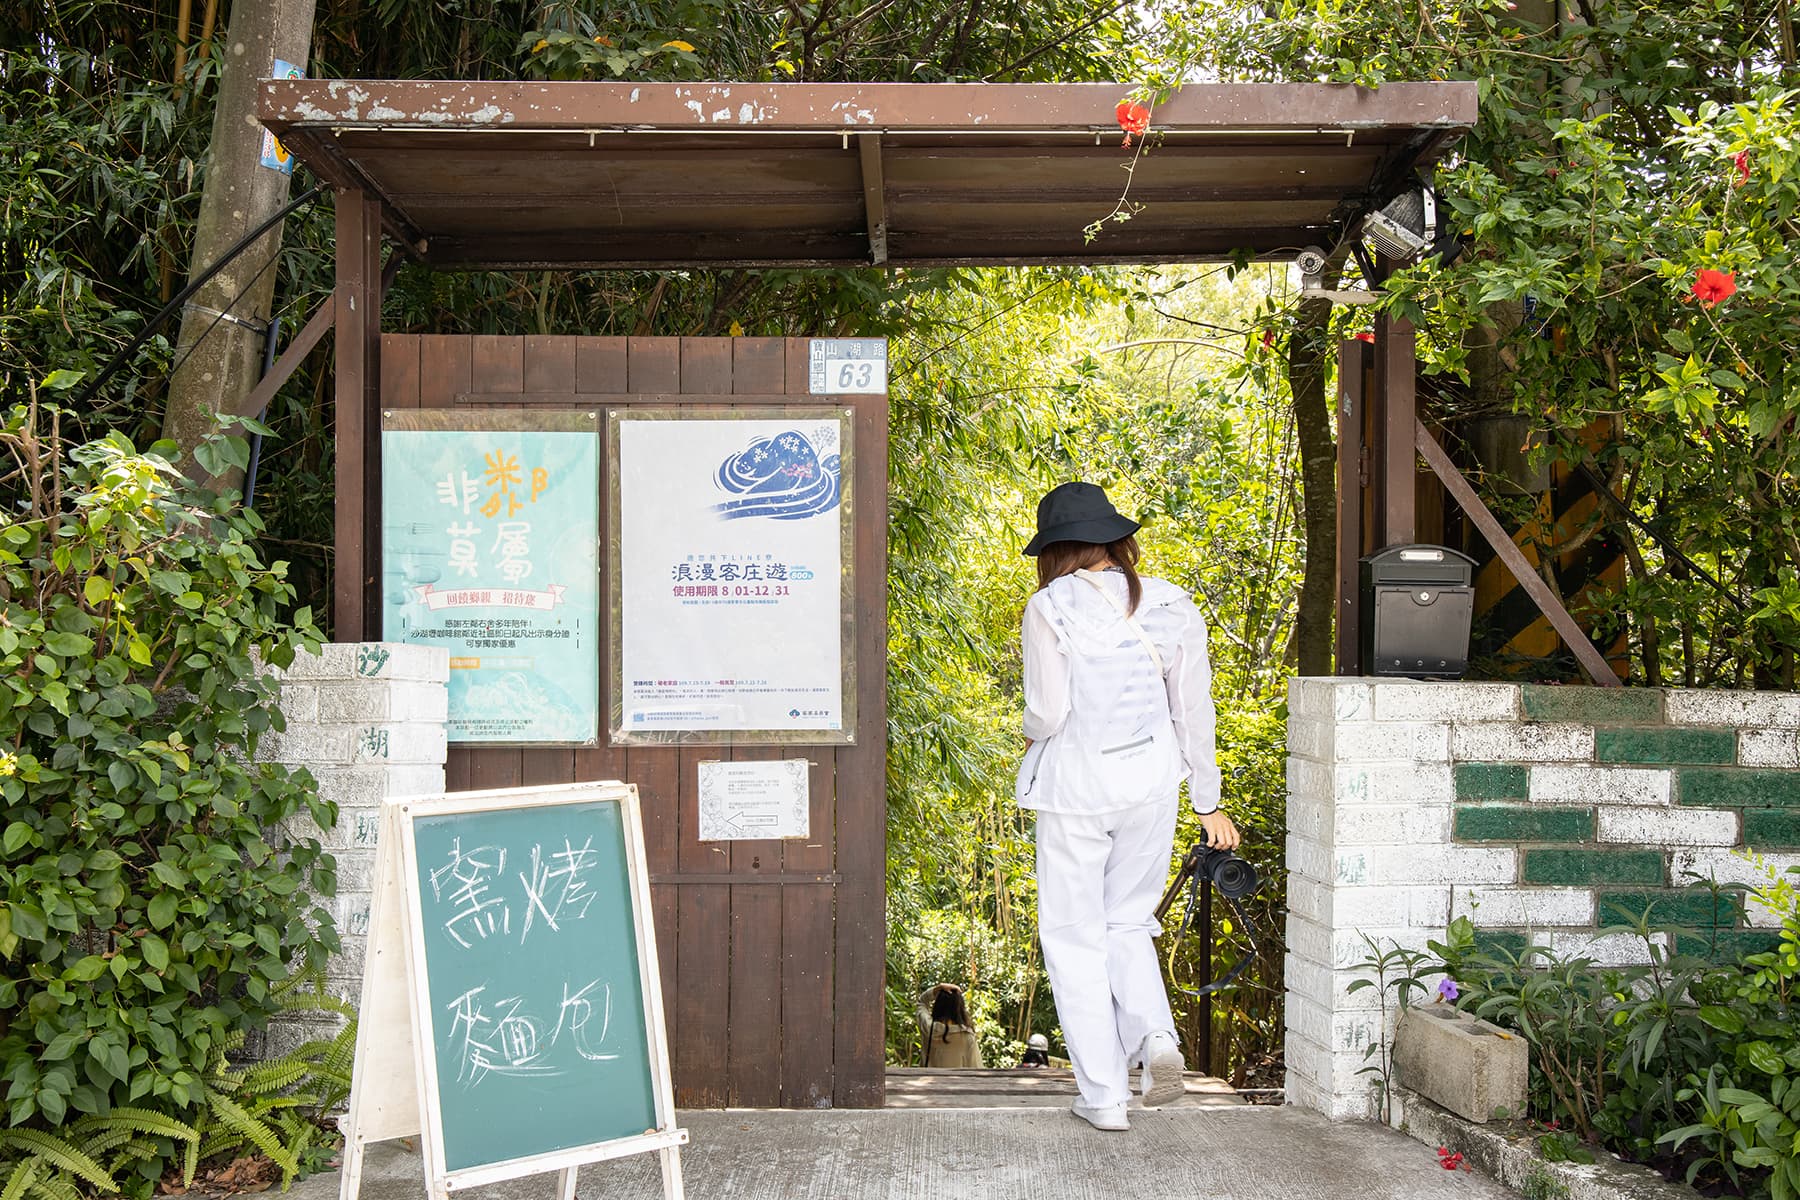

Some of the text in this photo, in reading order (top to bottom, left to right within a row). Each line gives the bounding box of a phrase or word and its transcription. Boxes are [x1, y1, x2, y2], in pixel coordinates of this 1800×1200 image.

[838, 363, 873, 389] 63
[446, 520, 534, 586] 莫屬
[672, 562, 788, 582] 浪漫客庄遊
[673, 585, 718, 597] 使用期限
